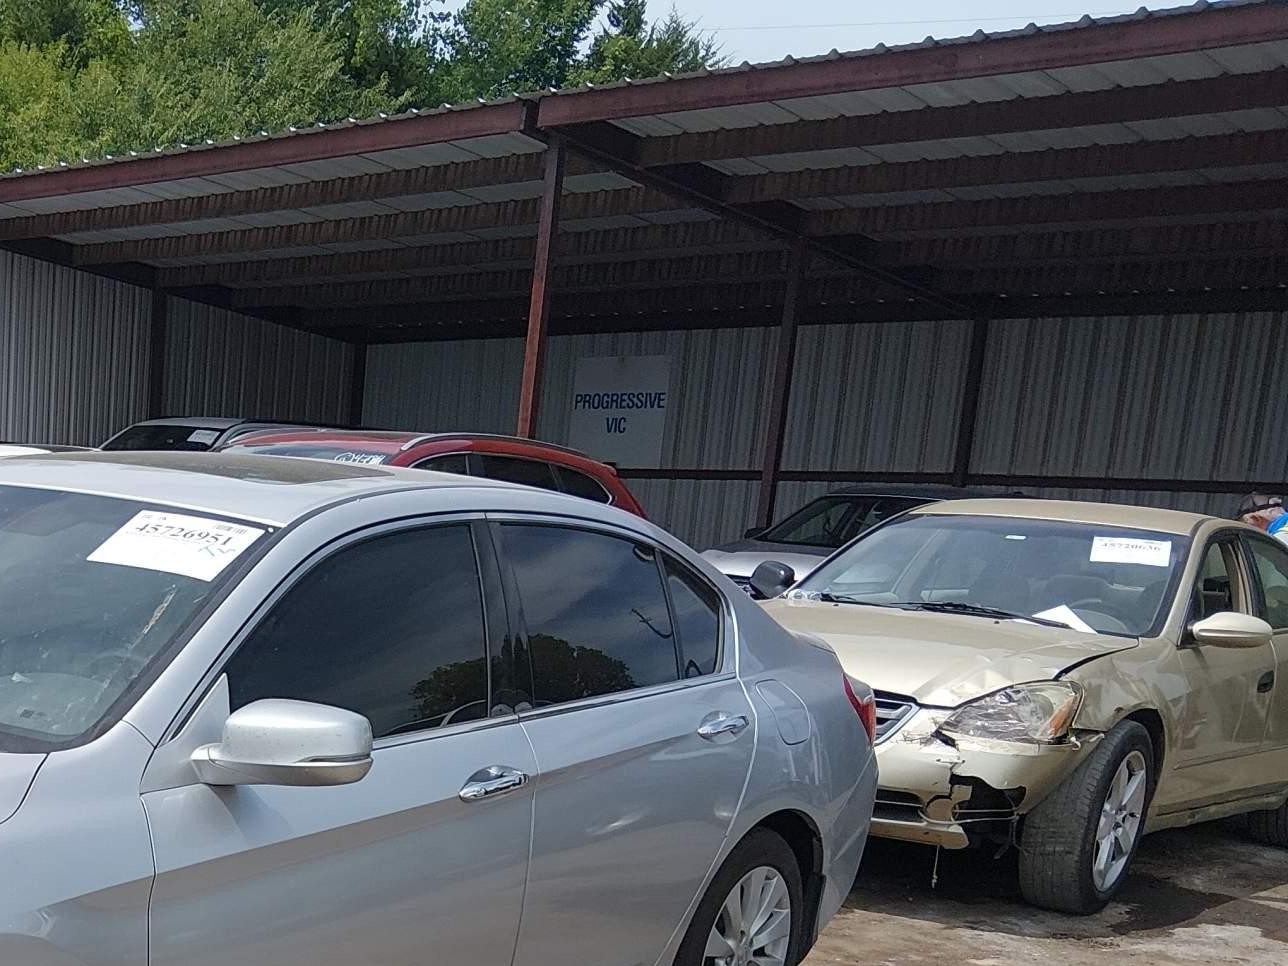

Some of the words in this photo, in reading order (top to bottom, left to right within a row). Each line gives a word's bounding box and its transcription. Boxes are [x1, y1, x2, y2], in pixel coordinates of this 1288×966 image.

[574, 392, 666, 410] PROGRESSIVE
[606, 417, 626, 433] VIC
[135, 522, 234, 547] 45726951
